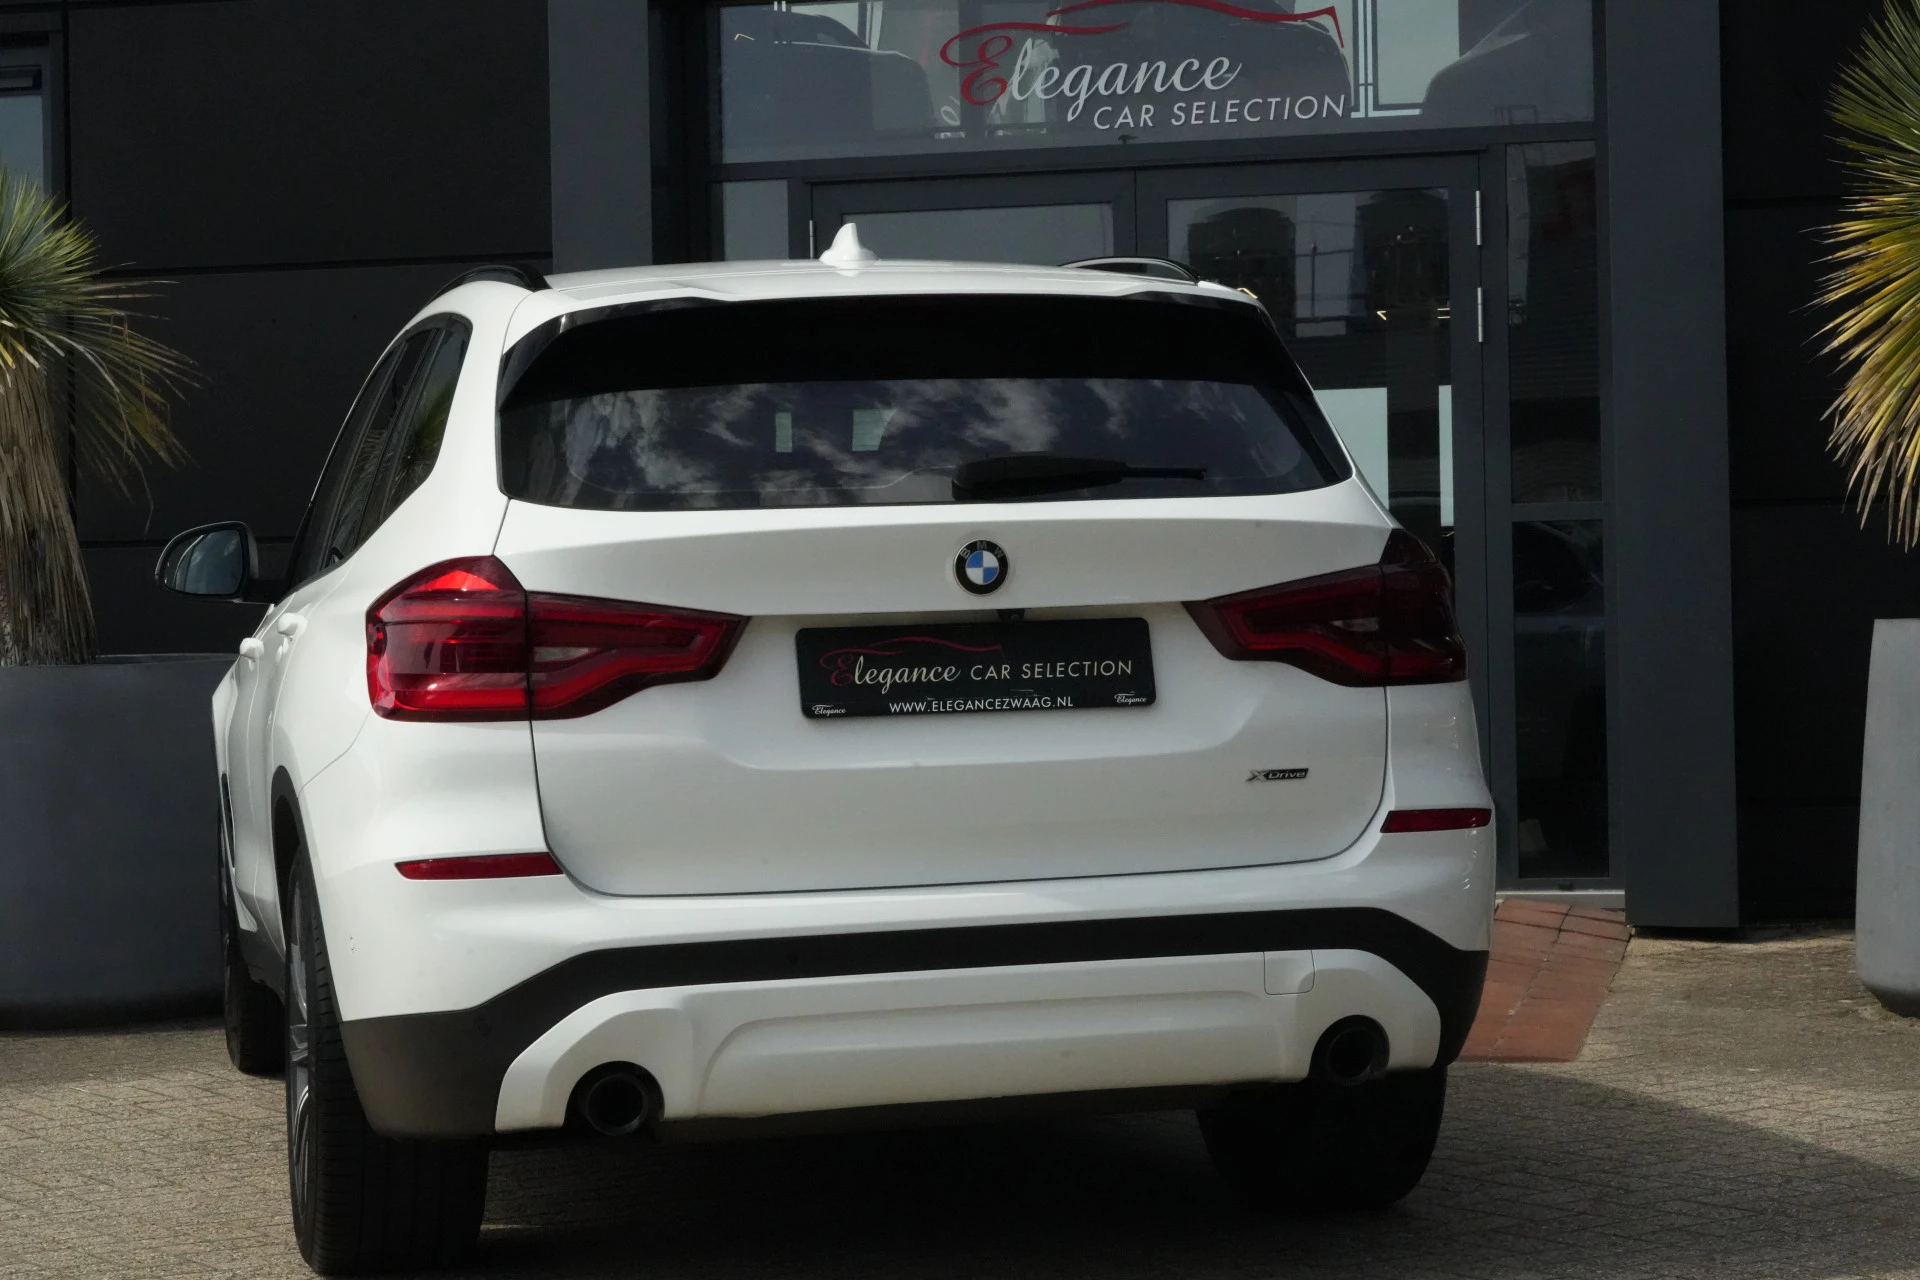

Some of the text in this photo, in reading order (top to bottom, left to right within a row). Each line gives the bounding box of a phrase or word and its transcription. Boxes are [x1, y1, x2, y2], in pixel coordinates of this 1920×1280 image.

[940, 23, 1242, 121] Elegance
[1093, 94, 1346, 130] CAR SELECTION
[959, 540, 1006, 560] BMW
[820, 650, 1133, 694] Elegance CAR SELECTION
[888, 696, 1074, 714] WWW.ELEGANCEZWAAG.NL
[1114, 693, 1147, 705] Elegance
[812, 704, 847, 717] Elegance
